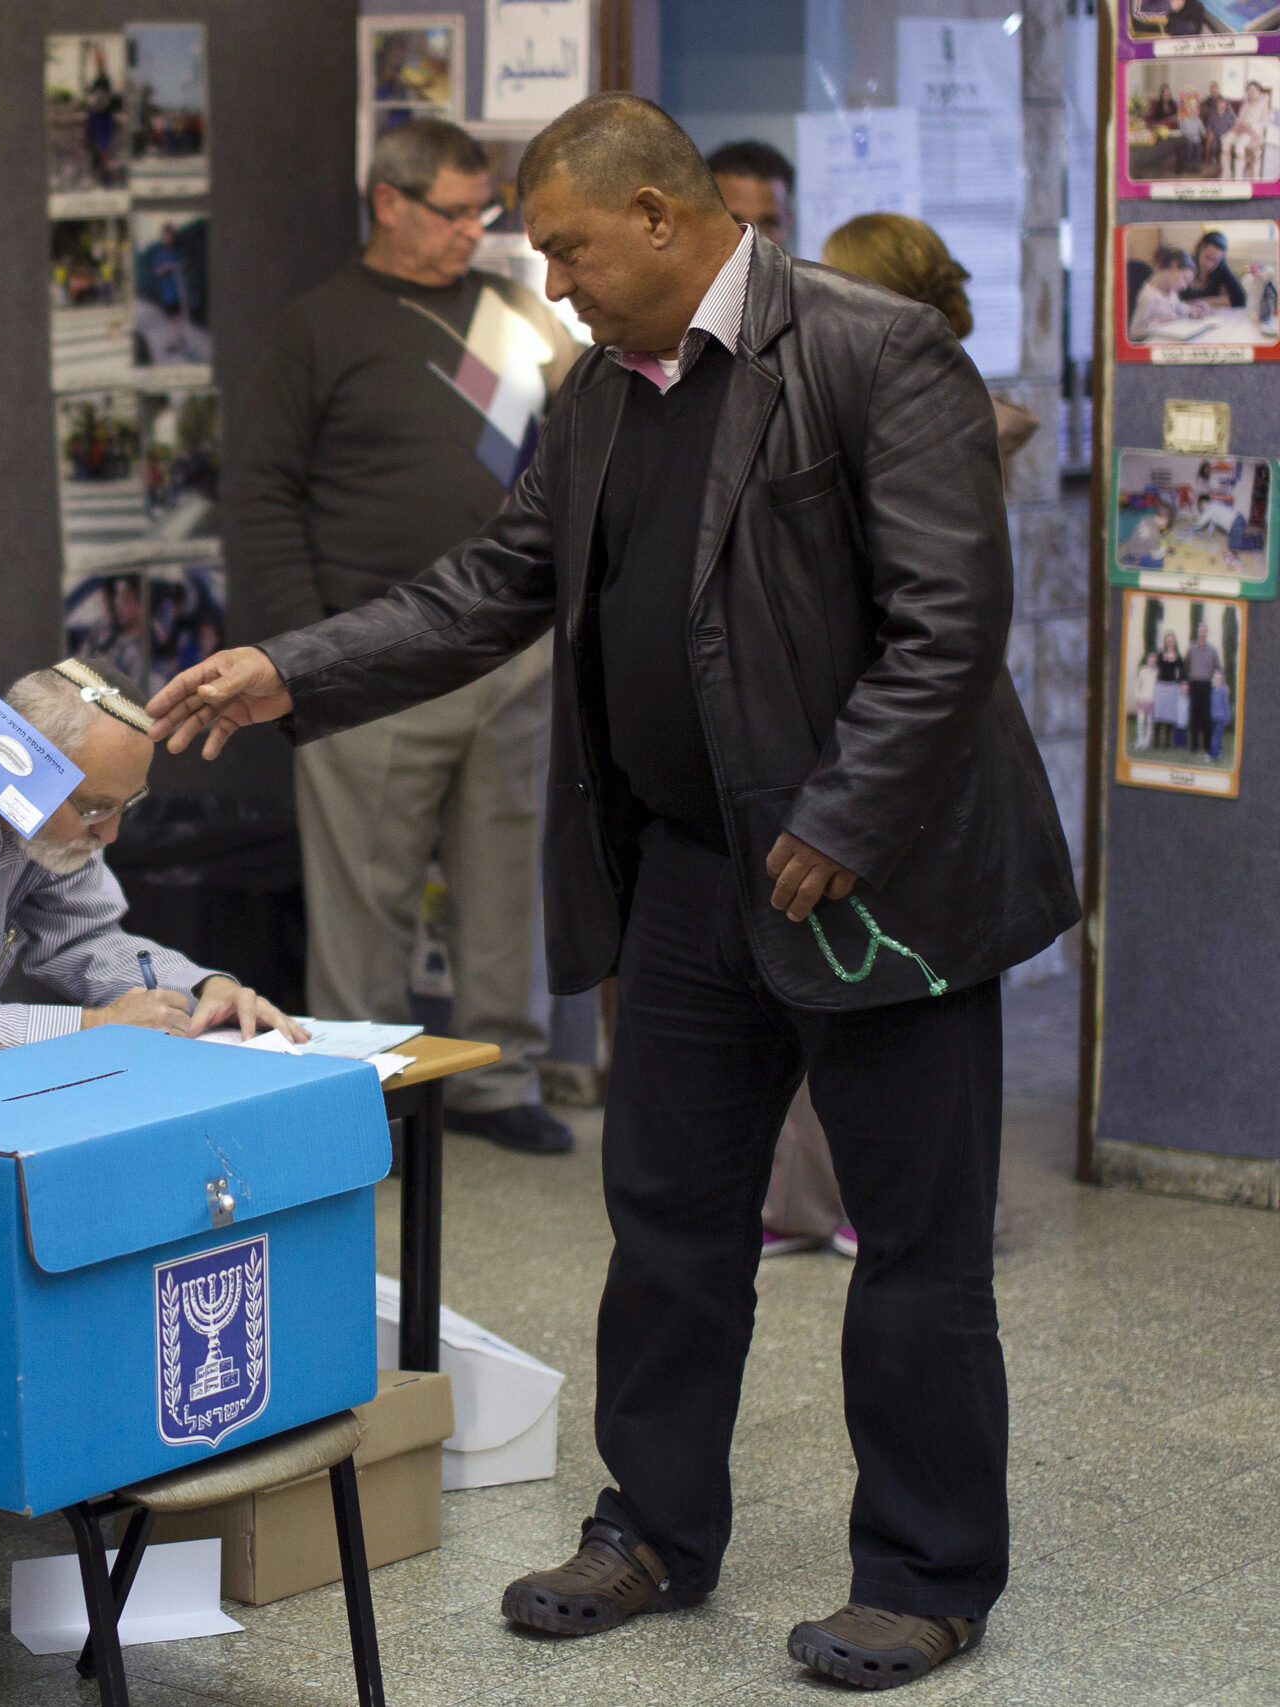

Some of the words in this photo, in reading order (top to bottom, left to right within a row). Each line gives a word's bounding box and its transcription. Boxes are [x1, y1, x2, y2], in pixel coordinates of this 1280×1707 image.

[26, 736, 46, 755] לכנסת
[44, 753, 65, 775] בחירות
[183, 1398, 246, 1434] ישראל
